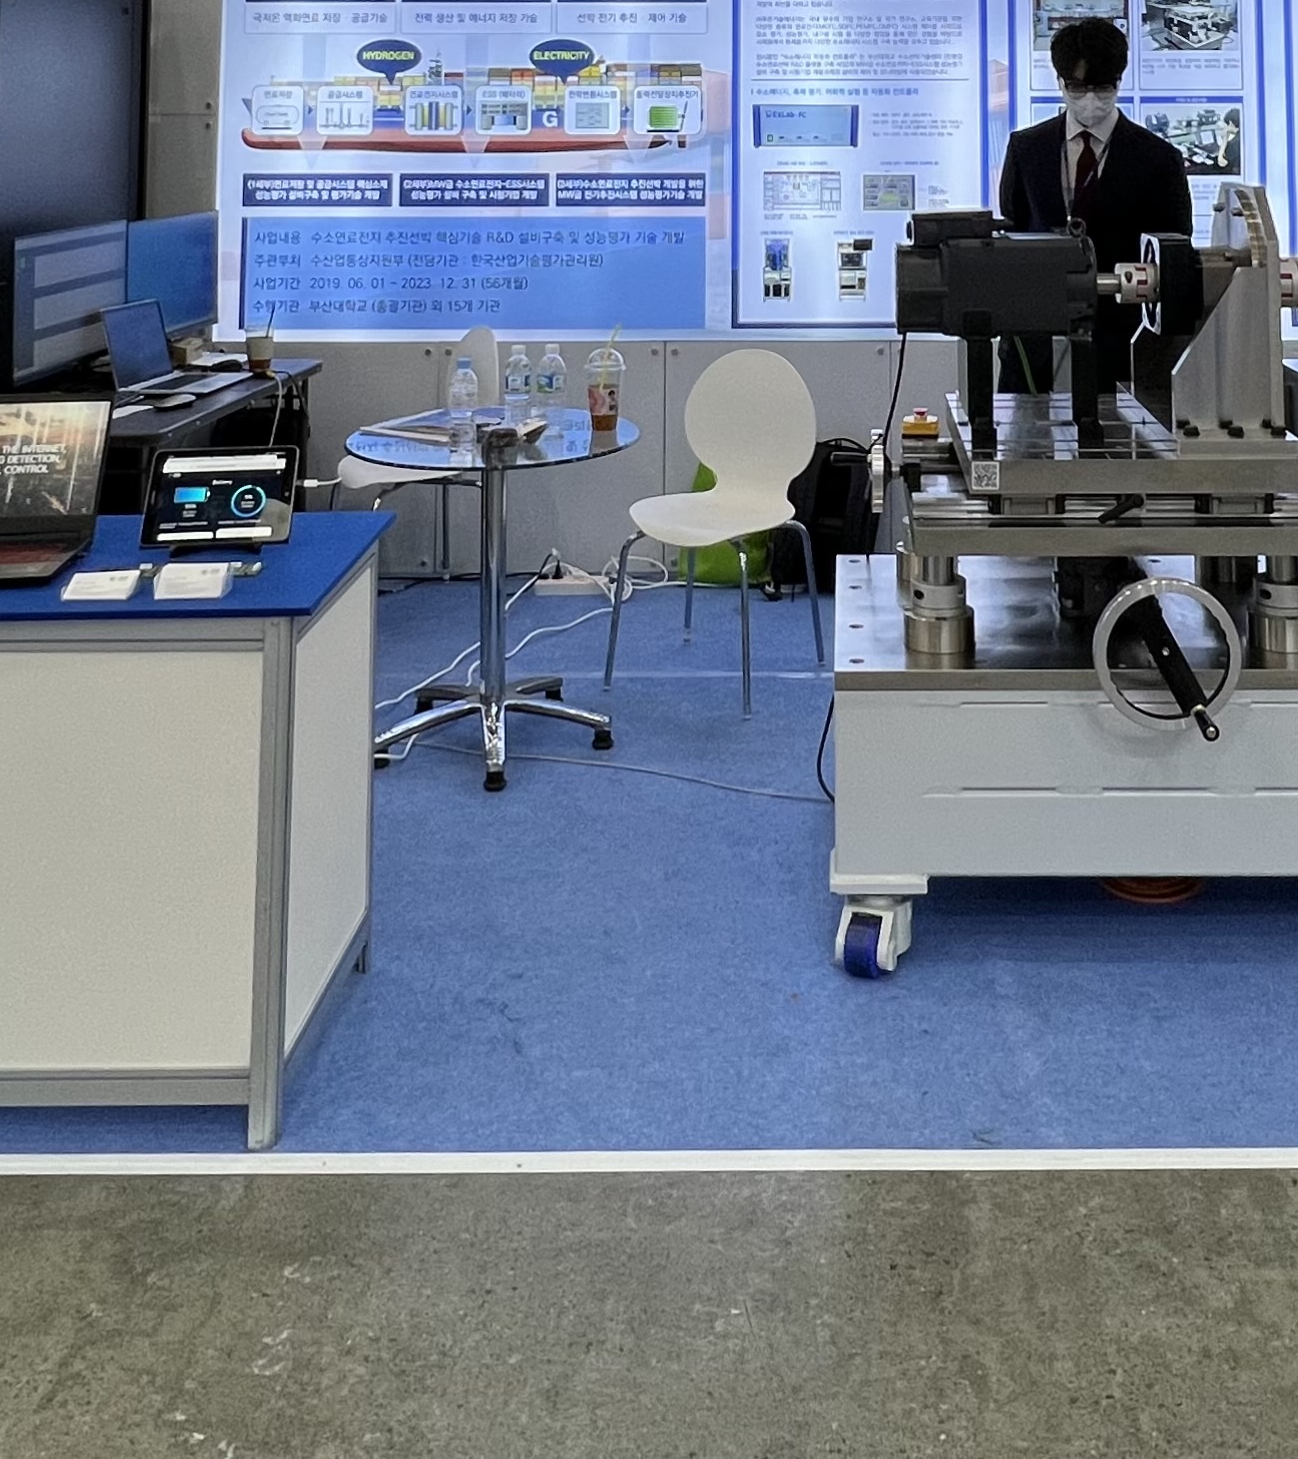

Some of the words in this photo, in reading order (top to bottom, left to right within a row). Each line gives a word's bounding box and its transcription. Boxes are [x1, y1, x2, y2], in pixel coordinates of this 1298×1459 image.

[415, 13, 433, 24] 전력
[435, 13, 455, 24] 생산
[469, 13, 497, 24] 에너지
[499, 13, 517, 24] 저장
[520, 13, 539, 24] 기술
[597, 13, 617, 24] 전기
[647, 13, 667, 24] 제어
[669, 13, 688, 24] 기술
[362, 50, 415, 61] HYDROGEN
[533, 50, 591, 61] ELECTRICITY
[687, 179, 705, 189] 위한
[687, 189, 703, 201] 개발
[254, 231, 302, 245] 사업내용
[311, 231, 381, 245] 수소연료전지
[385, 231, 433, 245] 추진선박
[435, 231, 482, 245] 핵심기술
[486, 231, 514, 245] R&D
[517, 231, 565, 245] 설비구축
[569, 231, 581, 245] 및
[584, 231, 631, 245] 성능평가
[635, 231, 657, 245] 기술
[661, 231, 685, 245] 개발
[254, 254, 302, 269] 주관부처
[407, 254, 459, 269] (전담기관
[471, 254, 604, 269] 한국산업기술평가관리원)
[253, 277, 301, 291] 사업기간
[370, 277, 385, 291] 01
[463, 277, 477, 291] 31
[481, 277, 529, 291] (56개월)
[309, 299, 367, 314] 부산대학교
[371, 299, 427, 314] (총괄기관)
[431, 299, 443, 314] 외
[447, 299, 473, 314] 15개
[477, 299, 501, 314] 기관
[3, 445, 20, 454] THE
[4, 465, 49, 474] CONTROL
